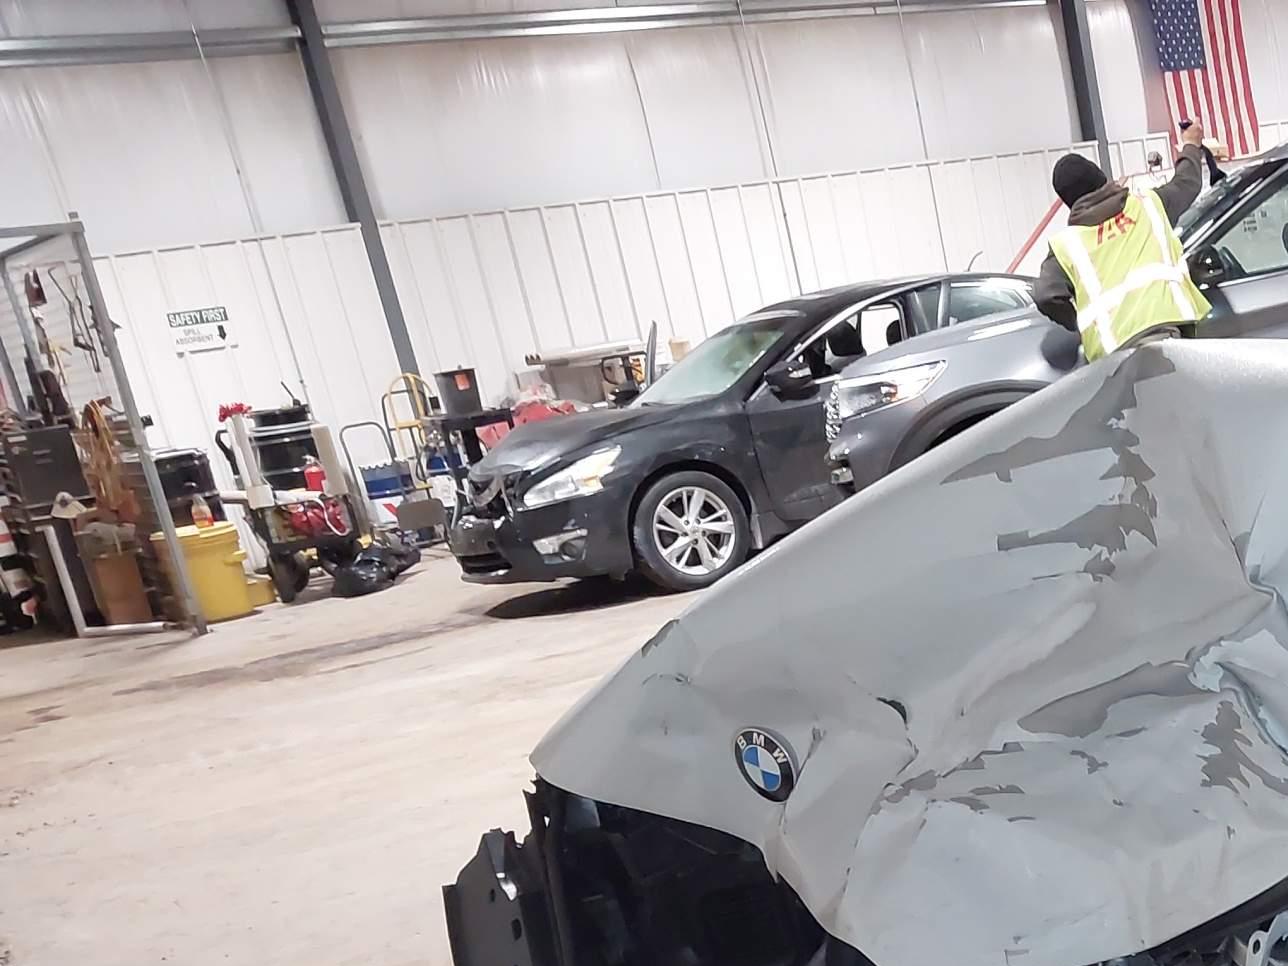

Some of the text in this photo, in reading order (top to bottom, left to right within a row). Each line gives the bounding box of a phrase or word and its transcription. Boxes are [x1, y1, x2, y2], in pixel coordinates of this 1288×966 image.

[168, 309, 225, 326] SAFETY FIRST
[176, 334, 214, 345] ABSORBENT
[736, 733, 787, 763] BMW
